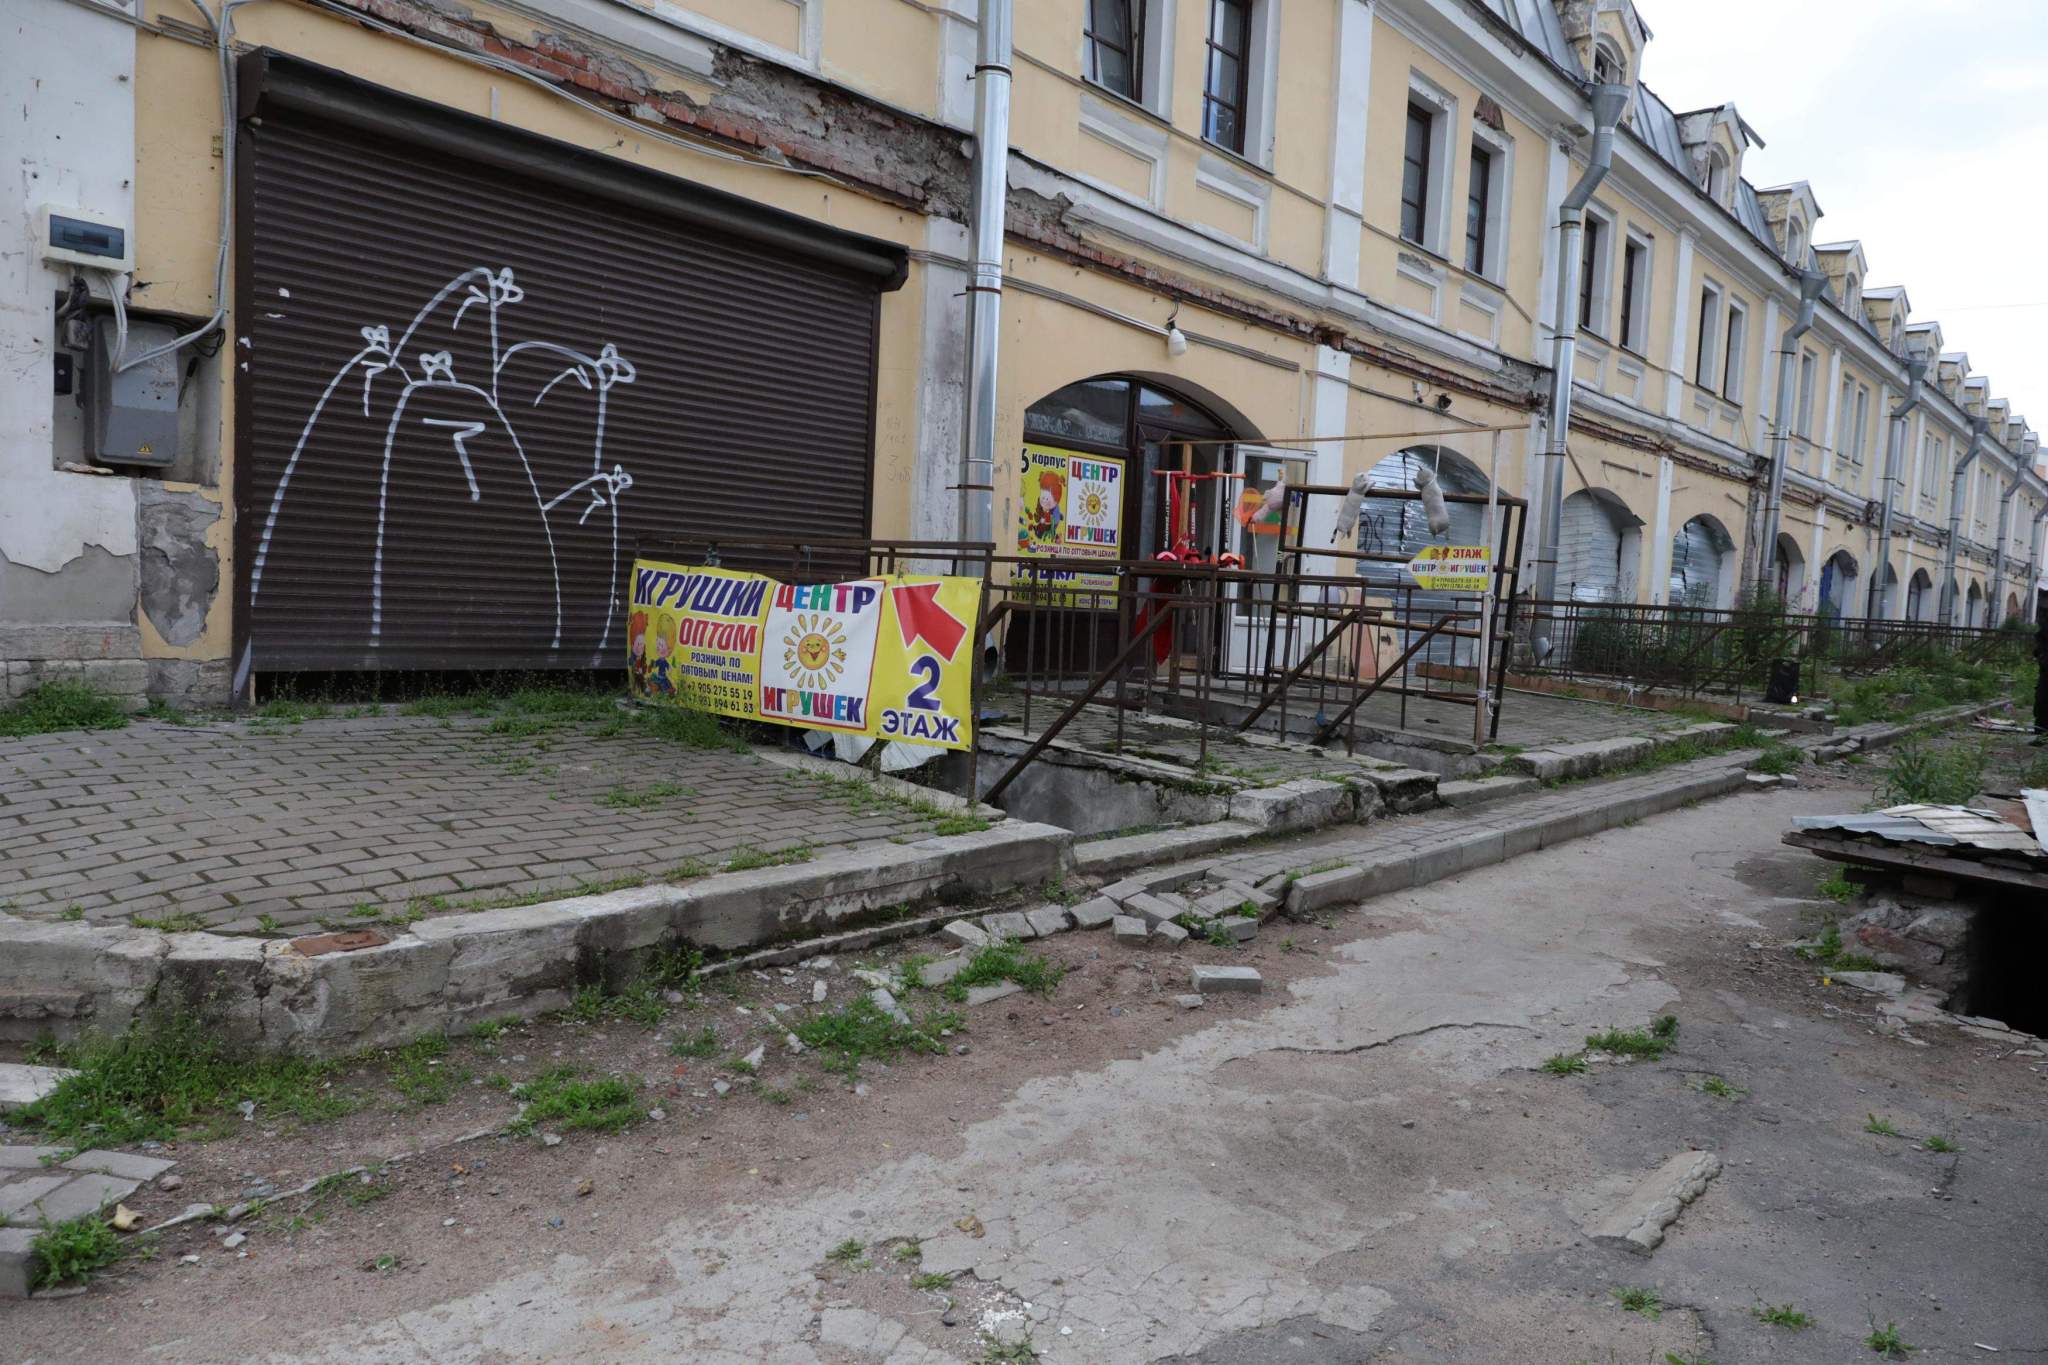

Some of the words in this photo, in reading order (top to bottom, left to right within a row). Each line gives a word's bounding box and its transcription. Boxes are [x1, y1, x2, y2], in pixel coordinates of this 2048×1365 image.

[1032, 453, 1067, 469] корпус
[1071, 461, 1119, 483] ЦЕНТР
[1067, 524, 1117, 544] ИГРУШЕК
[1453, 548, 1483, 559] ЭТАЖ
[1412, 563, 1437, 573] ЦЕНТР
[1450, 563, 1486, 574] ИГРУШЕК
[634, 567, 768, 617] ИГРУШКИ
[775, 584, 876, 614] ЦЕНТР
[679, 617, 758, 654] ОПТОМ
[691, 651, 726, 668] РОЗНИЦА
[729, 657, 741, 668] ПО
[681, 664, 718, 680] ОПТОВЫМ
[721, 670, 753, 685] ЦЕНАМ!
[907, 655, 942, 712] 2
[698, 682, 711, 695] 905
[713, 685, 728, 697] 275
[730, 687, 740, 699] 55
[743, 689, 753, 701] 19
[731, 699, 741, 711] 61
[743, 702, 754, 714] 83
[763, 686, 864, 724] ИГРУШЕК
[881, 709, 960, 742] ЭТАЖ
